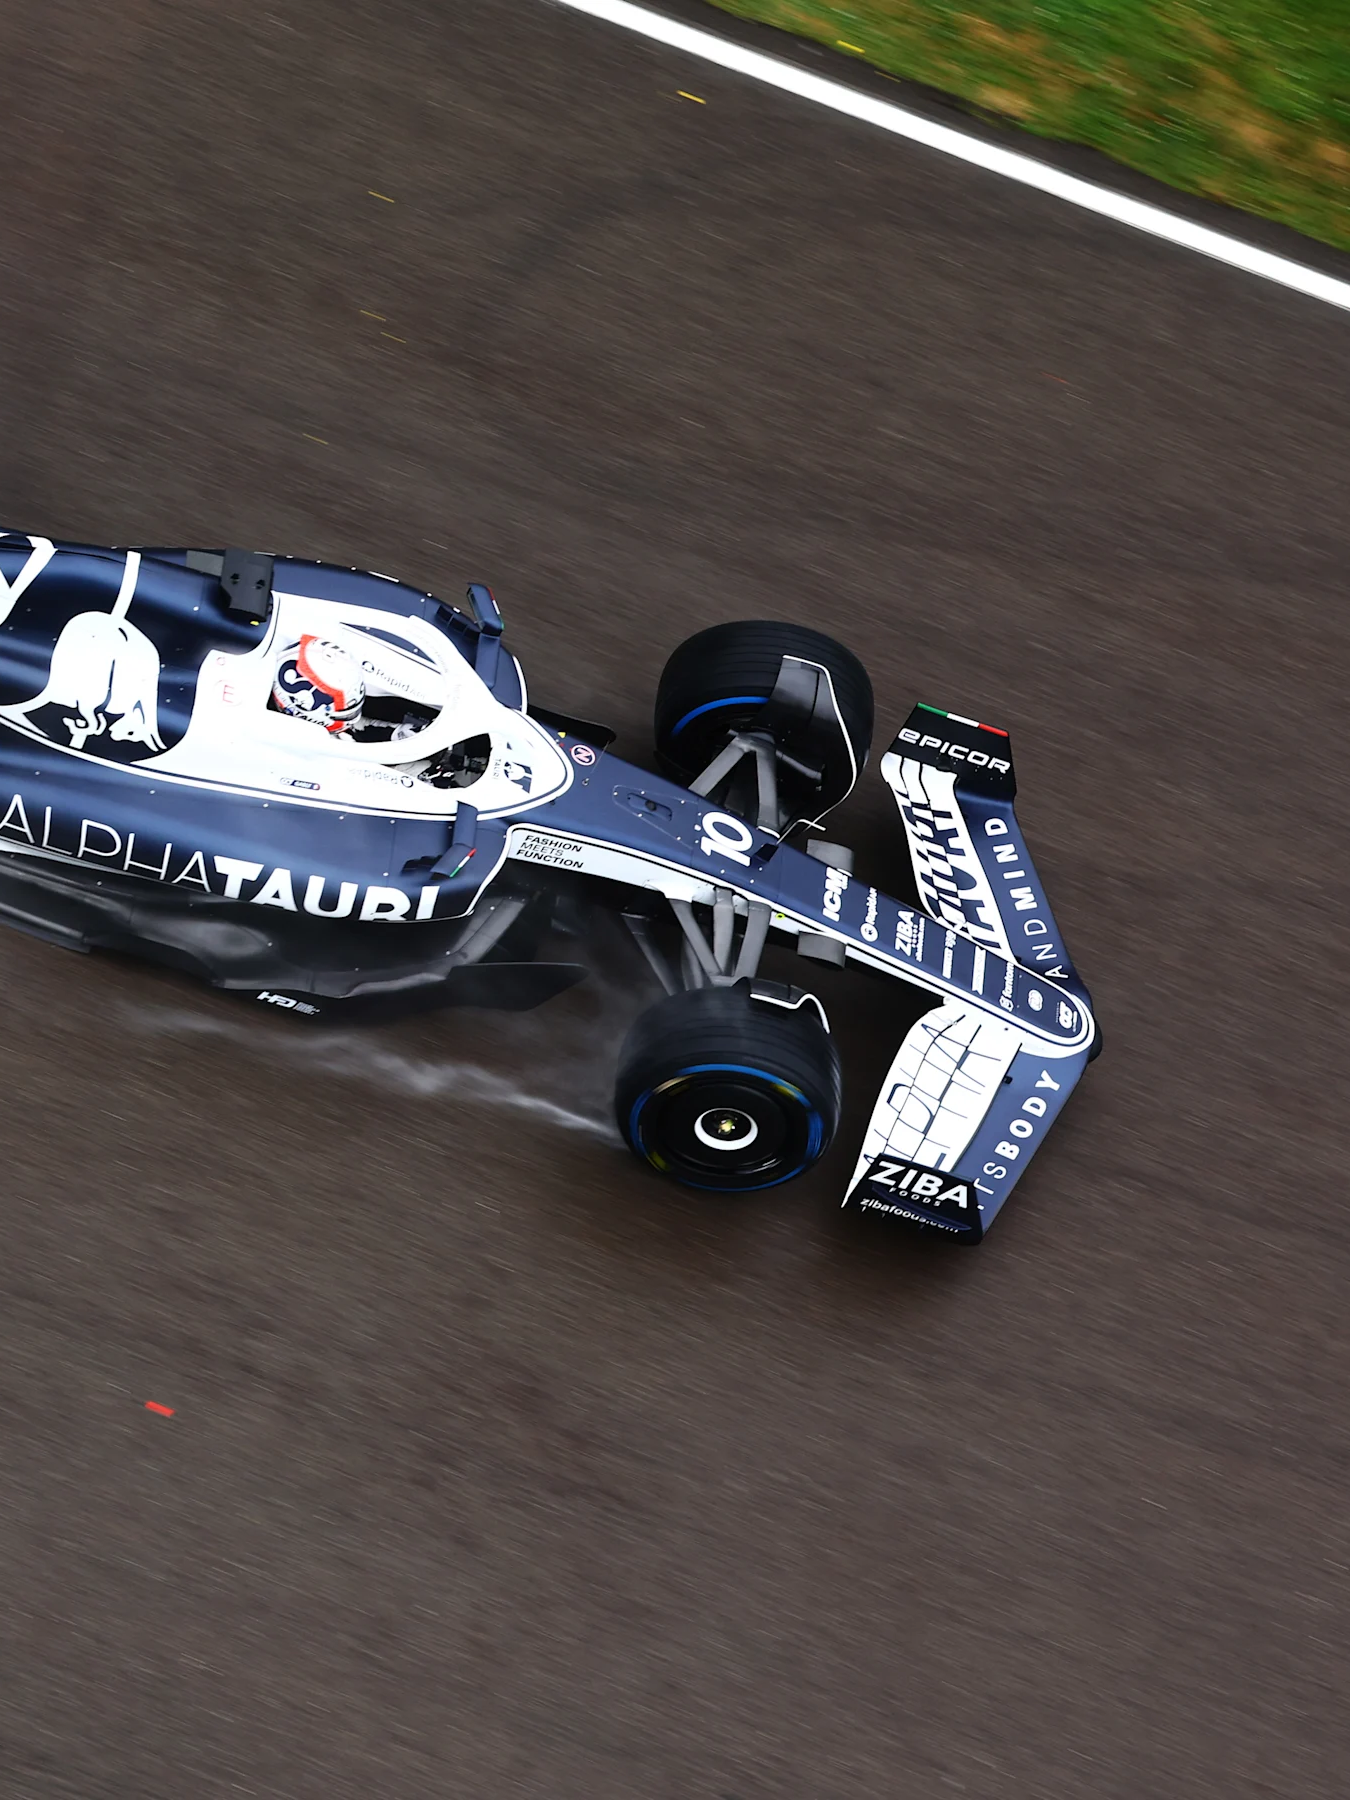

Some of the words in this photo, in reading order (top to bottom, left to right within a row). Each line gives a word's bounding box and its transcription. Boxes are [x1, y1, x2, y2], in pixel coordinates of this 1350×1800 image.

[520, 842, 564, 857] MEETS
[524, 834, 583, 852] FASHION
[699, 810, 754, 867] 10
[516, 849, 584, 869] FUNCTION
[822, 866, 845, 923] ICM
[894, 909, 915, 957] ZIBA
[1002, 961, 1015, 999] fantom
[867, 1159, 970, 1210] ZIBA
[888, 1186, 942, 1208] FOODS
